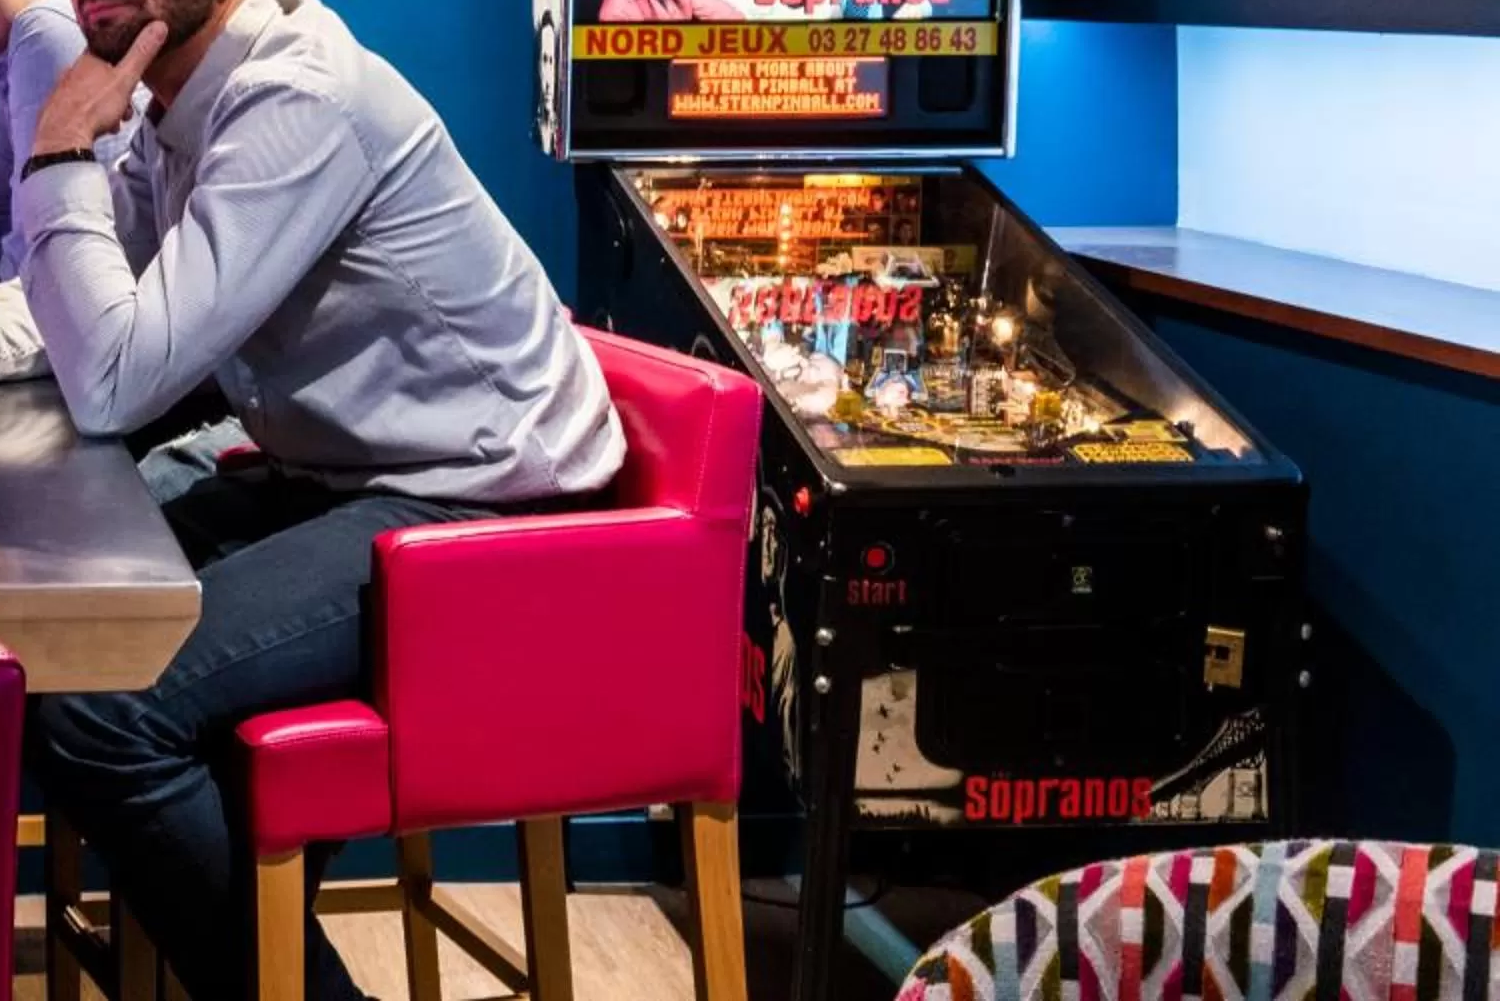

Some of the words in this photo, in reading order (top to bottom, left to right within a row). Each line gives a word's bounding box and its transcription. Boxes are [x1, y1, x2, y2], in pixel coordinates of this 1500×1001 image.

[586, 28, 684, 55] NORD
[698, 27, 789, 54] JEUX
[808, 28, 836, 52] 03
[844, 27, 871, 52] 27
[879, 27, 907, 51] 48
[915, 27, 942, 51] 86
[951, 27, 977, 51] 43
[699, 61, 750, 77] LEARN
[756, 61, 798, 77] MORE
[805, 60, 857, 77] ABOUT
[700, 78, 752, 94] STERN
[759, 78, 828, 94] PINBALL
[834, 77, 857, 93] AT
[673, 94, 880, 111] WWW.STERNPINBALL.COM
[964, 774, 1154, 823] Sopranos
